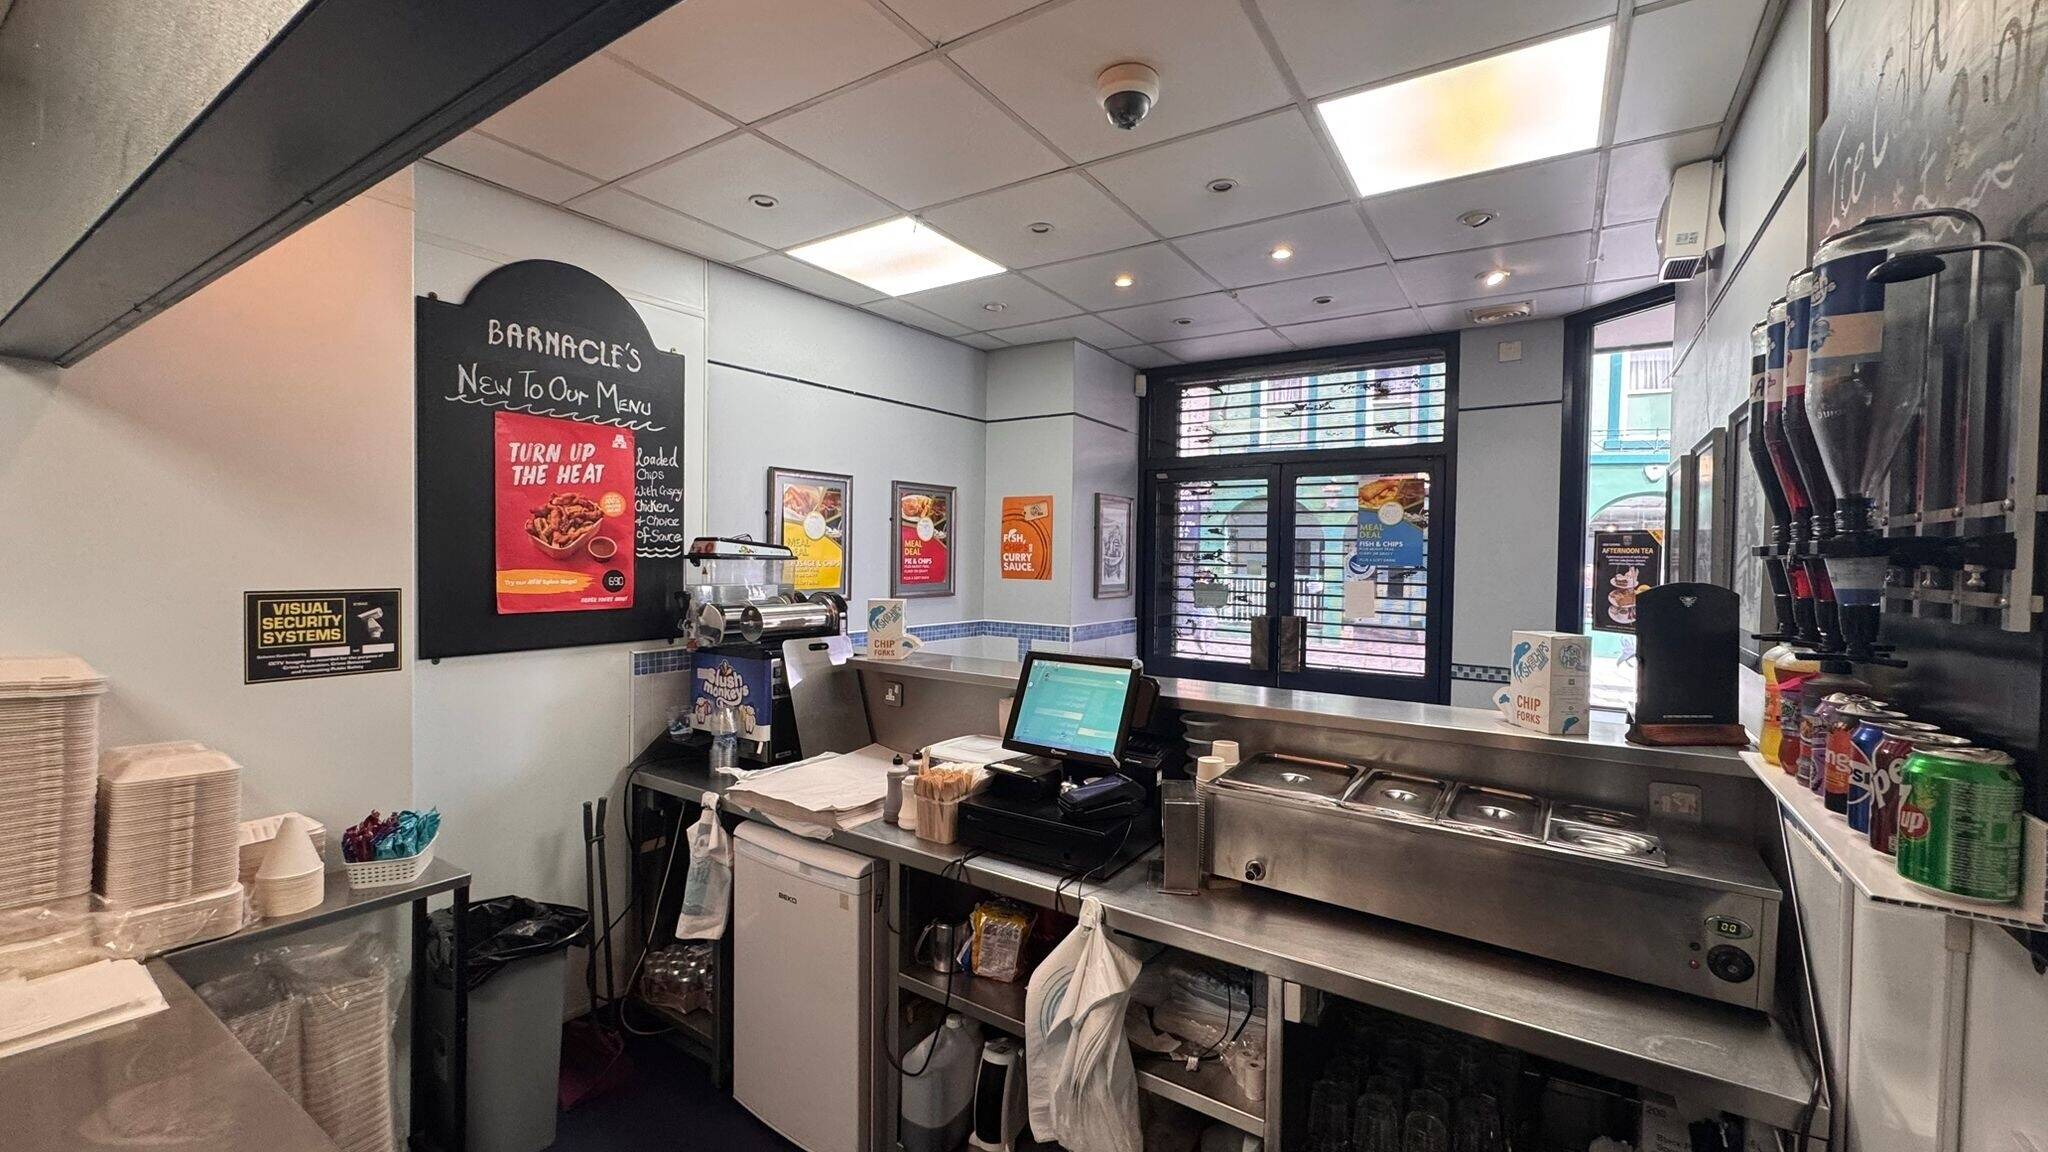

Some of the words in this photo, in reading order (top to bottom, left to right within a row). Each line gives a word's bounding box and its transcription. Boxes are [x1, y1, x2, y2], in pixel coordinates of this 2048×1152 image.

[488, 319, 641, 373] BARNACLE'S
[518, 370, 544, 399] To
[508, 443, 563, 463] TURN
[569, 443, 597, 462] UP
[636, 446, 679, 468] Loaded
[511, 464, 549, 486] THE
[556, 463, 605, 485] HEAT
[636, 468, 664, 486] Chips
[646, 515, 680, 527] Choice
[650, 529, 683, 543] Sauce
[1359, 531, 1382, 539] DEAL
[904, 539, 922, 548] MEAL
[904, 547, 921, 555] DEAL
[1003, 552, 1032, 562] CURRY
[1003, 562, 1034, 571] SAUCE.
[273, 602, 332, 616] VISUAL
[262, 614, 342, 630] SECURITY
[263, 628, 341, 644] SYSTEMS
[874, 639, 895, 648] CHIP
[1517, 695, 1541, 711] CHIP
[1517, 710, 1541, 725] FORKS
[778, 892, 797, 904] BEKO
